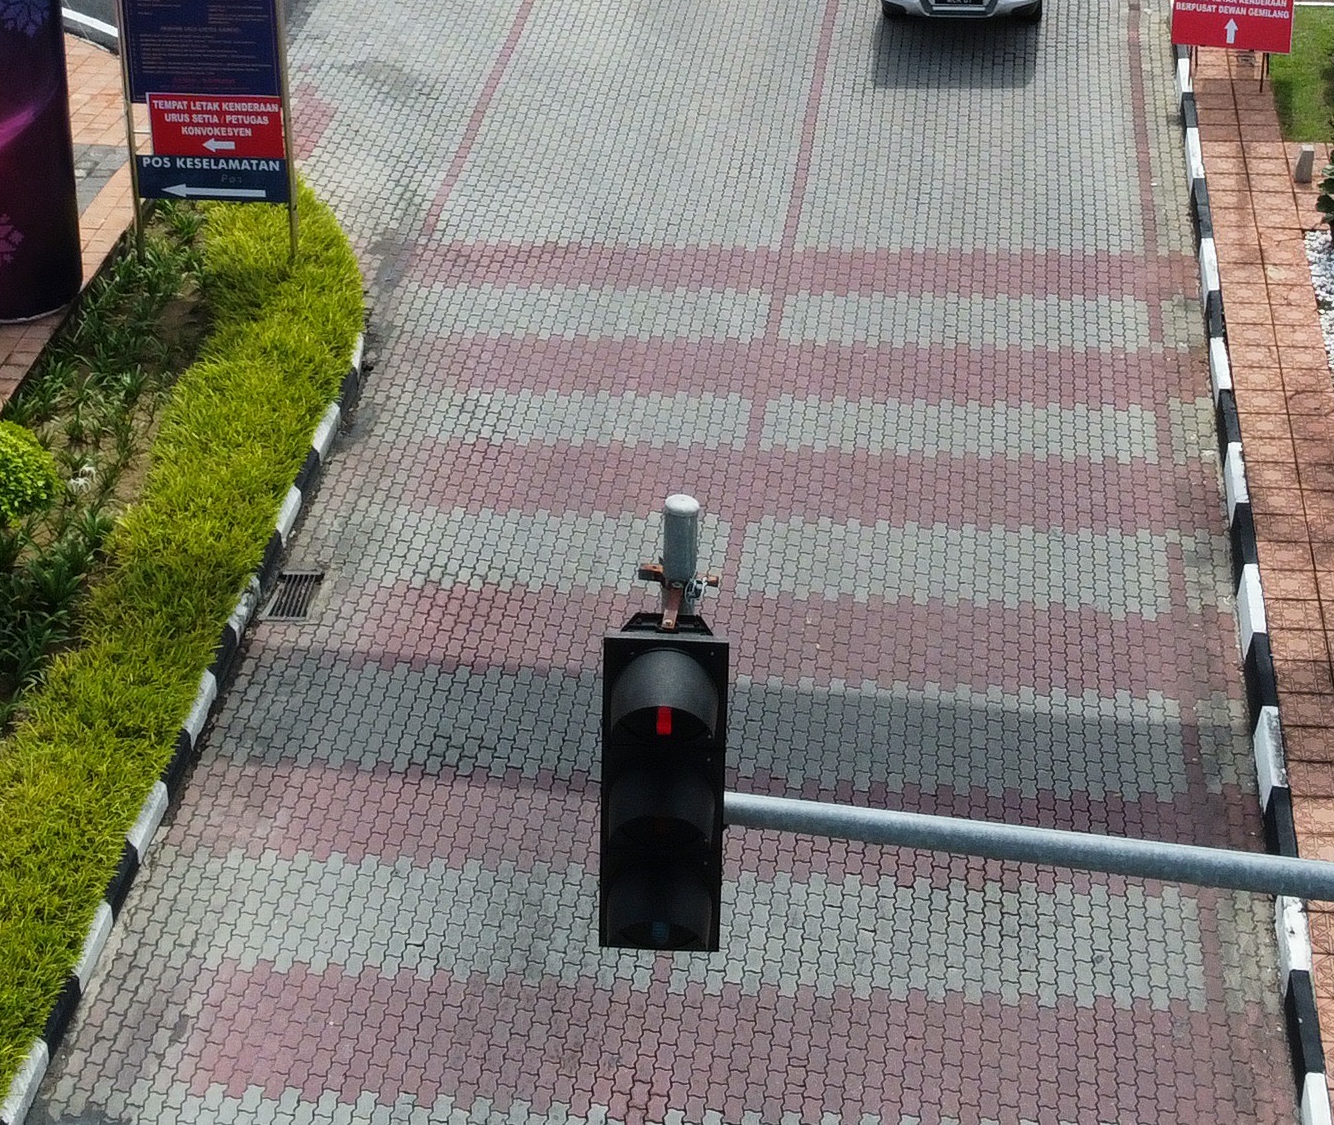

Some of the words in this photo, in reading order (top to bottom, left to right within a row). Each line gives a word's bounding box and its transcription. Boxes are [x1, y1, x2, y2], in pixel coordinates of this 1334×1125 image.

[1175, 1, 1218, 13] BERPUSAT
[1218, 5, 1247, 15] DEWAN
[1247, 7, 1290, 19] GEMILANG
[152, 99, 188, 111] TEMPAT
[190, 100, 221, 111] LETAK
[222, 102, 279, 113] KENDERAAN
[164, 113, 190, 123] URUS
[192, 114, 219, 124] SETIA
[226, 115, 269, 125] PETUGAS
[181, 126, 253, 137] KONVOKESYEN
[142, 156, 171, 168] POS
[176, 157, 280, 172] KESELAMATAN
